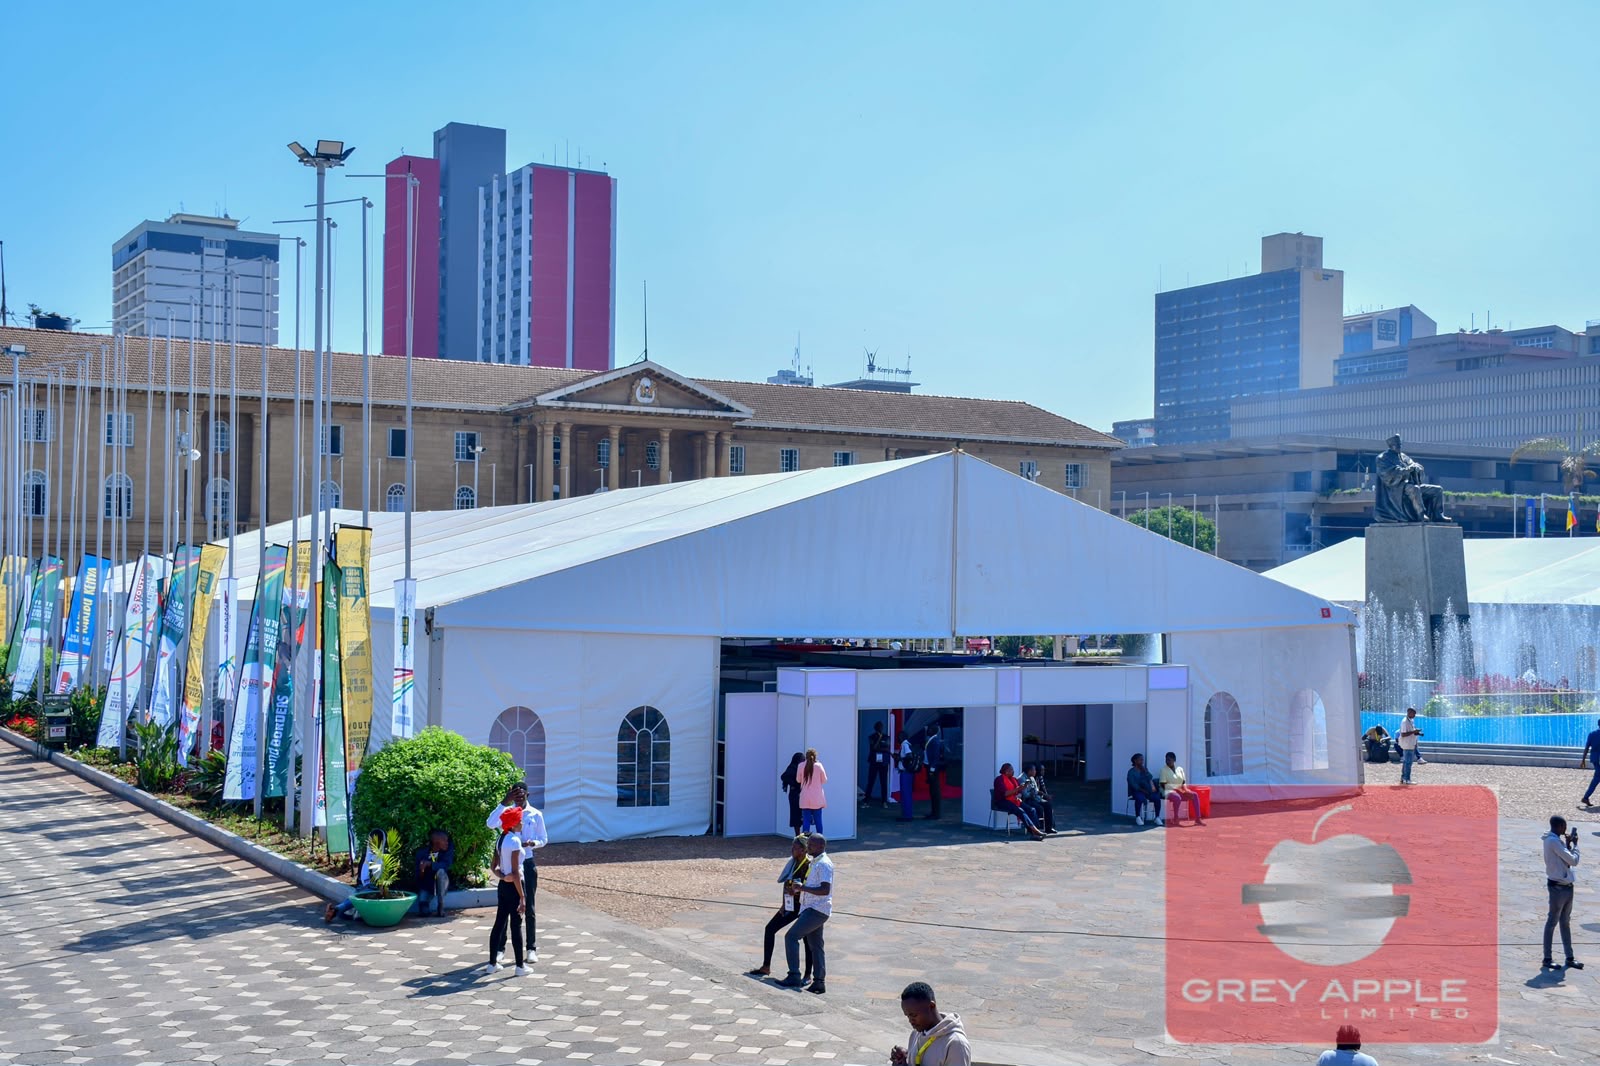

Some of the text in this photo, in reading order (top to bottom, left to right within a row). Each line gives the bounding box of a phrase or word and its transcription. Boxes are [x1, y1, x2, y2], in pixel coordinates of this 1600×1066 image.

[83, 567, 98, 596] KENYA
[255, 616, 279, 629] YUTH
[273, 695, 289, 747] BORDERS
